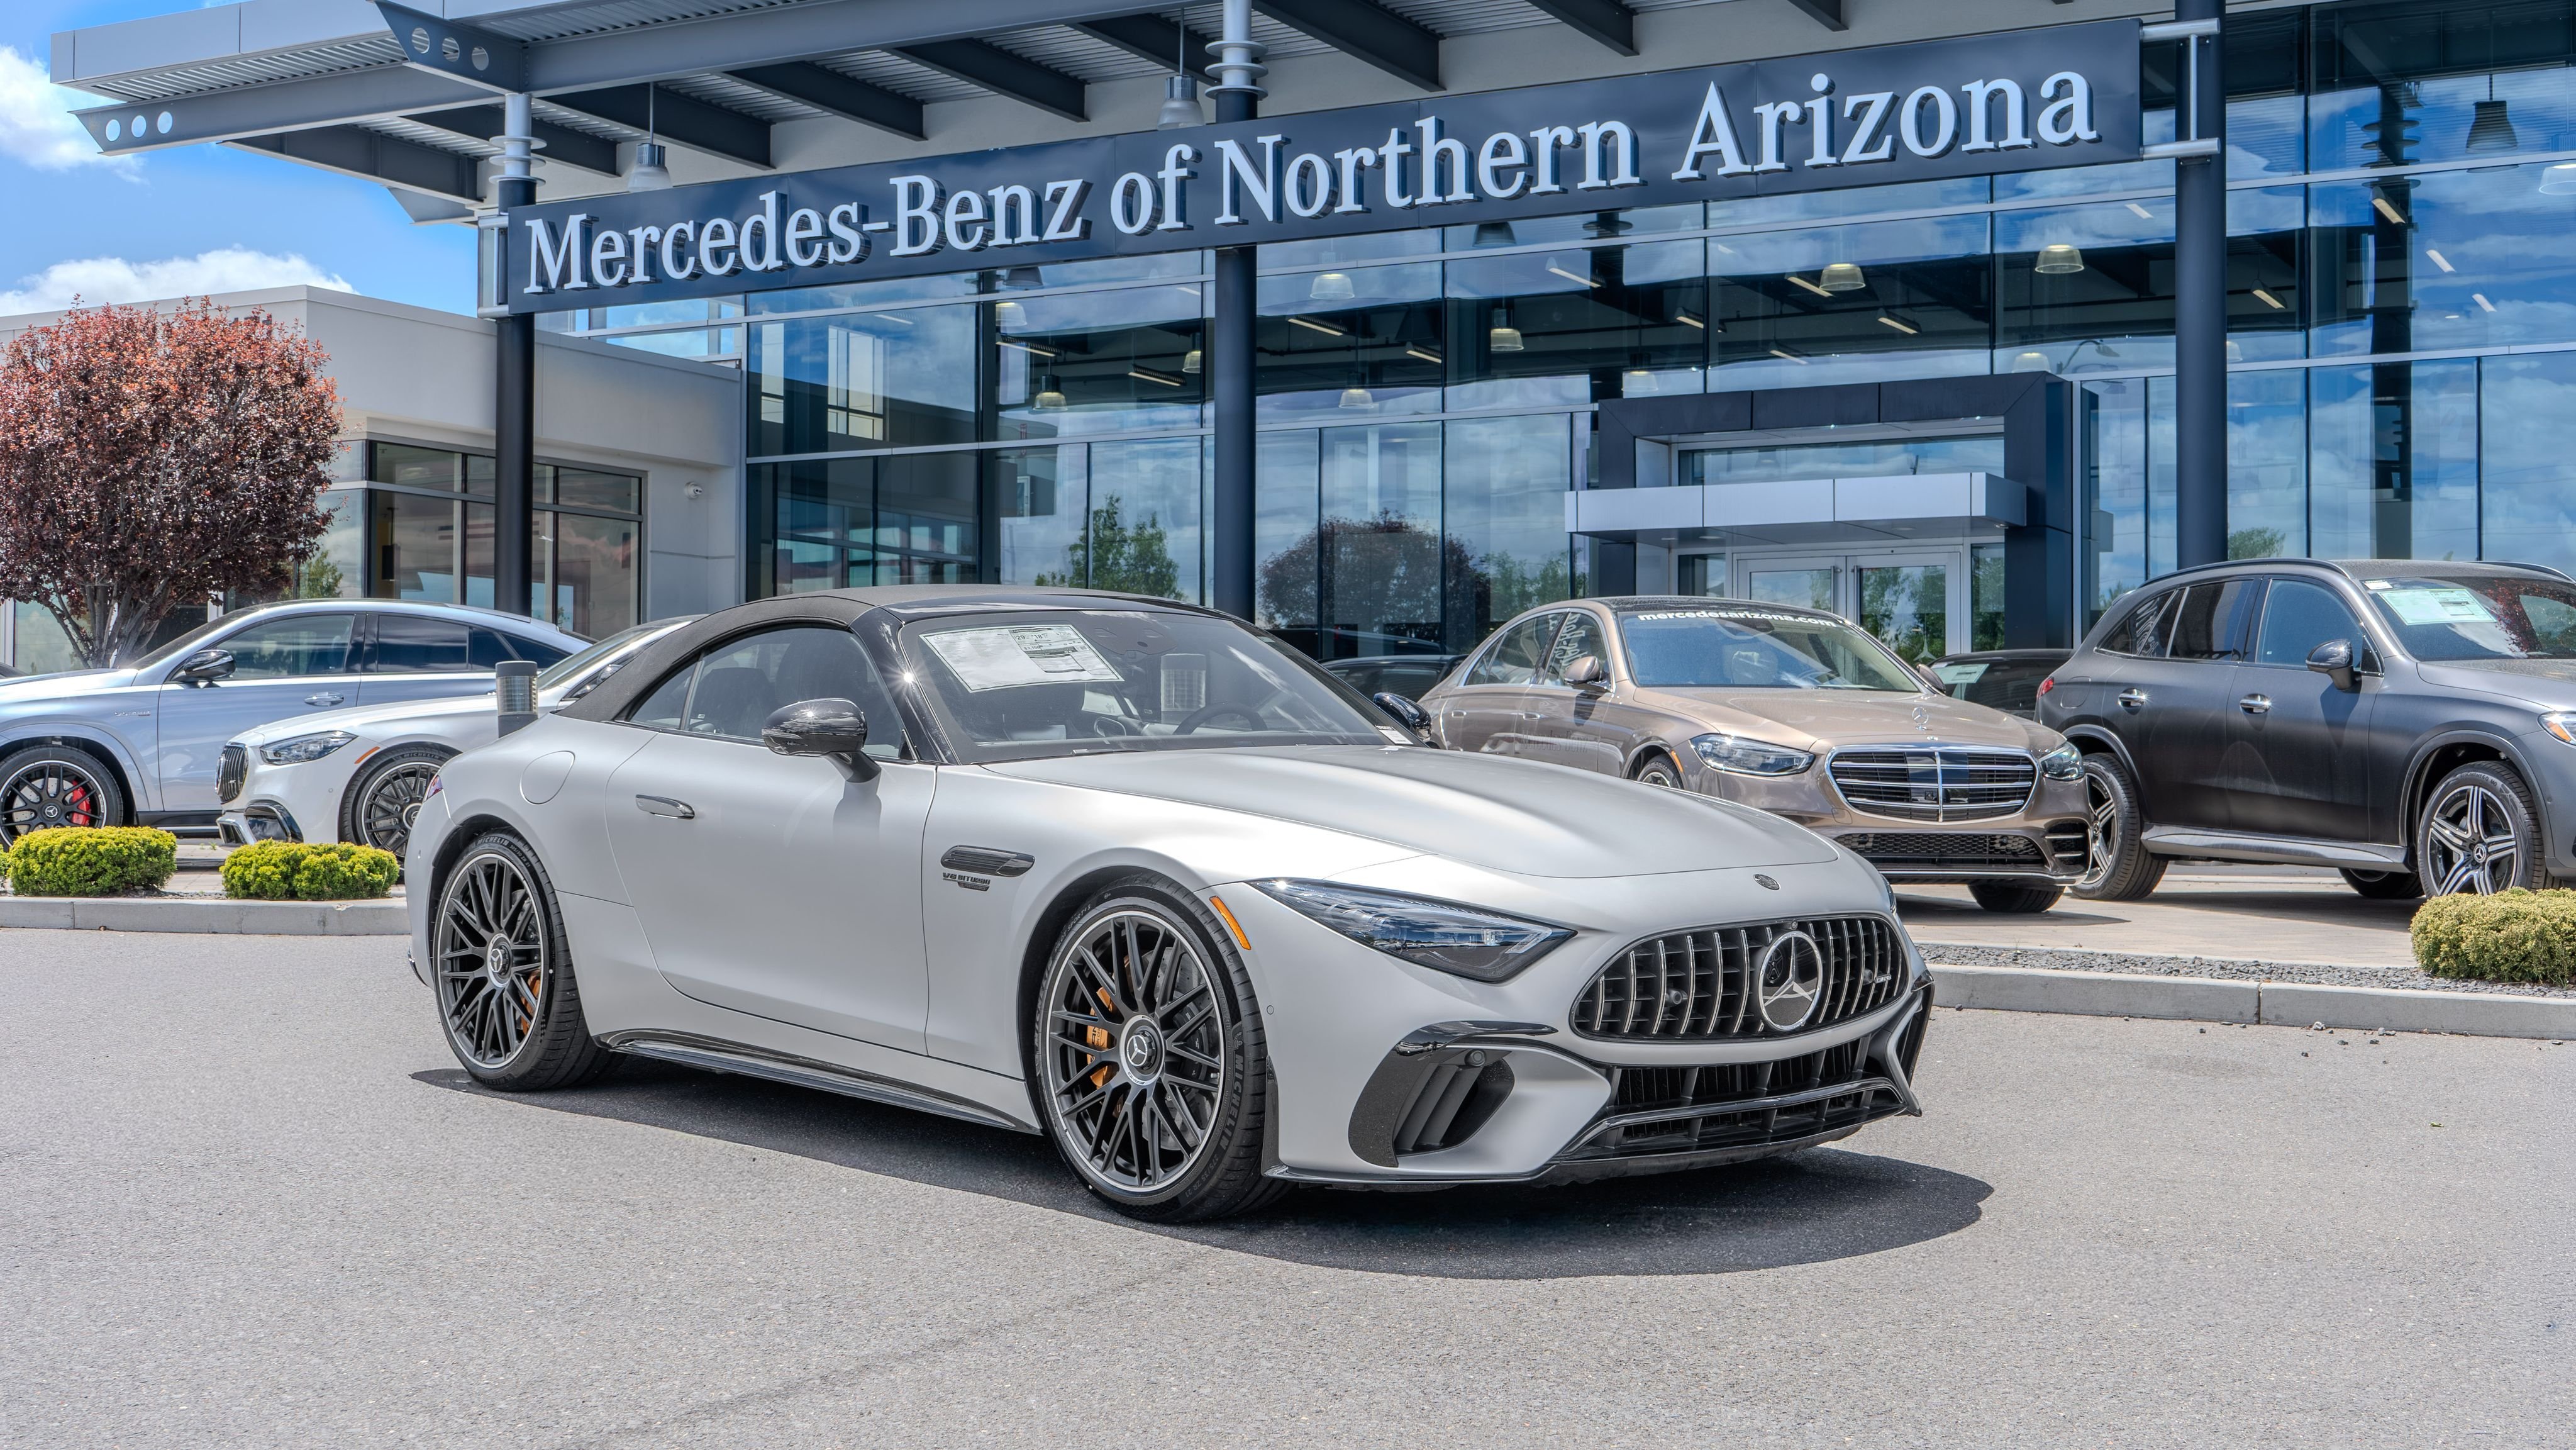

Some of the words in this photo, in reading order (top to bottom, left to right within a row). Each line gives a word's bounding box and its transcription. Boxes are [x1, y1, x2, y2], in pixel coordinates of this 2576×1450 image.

[524, 175, 1085, 294] Mercedes-Benz
[1111, 144, 1192, 233] of
[1214, 116, 1631, 224] Northern
[1672, 72, 2097, 181] Arizona
[1638, 611, 1836, 627] mercedesarizona.com
[477, 836, 509, 846] MICHELIN
[1067, 910, 1084, 932] SPORT
[1219, 1054, 1244, 1151] MICHELIN
[1201, 1154, 1219, 1182] 275/35
